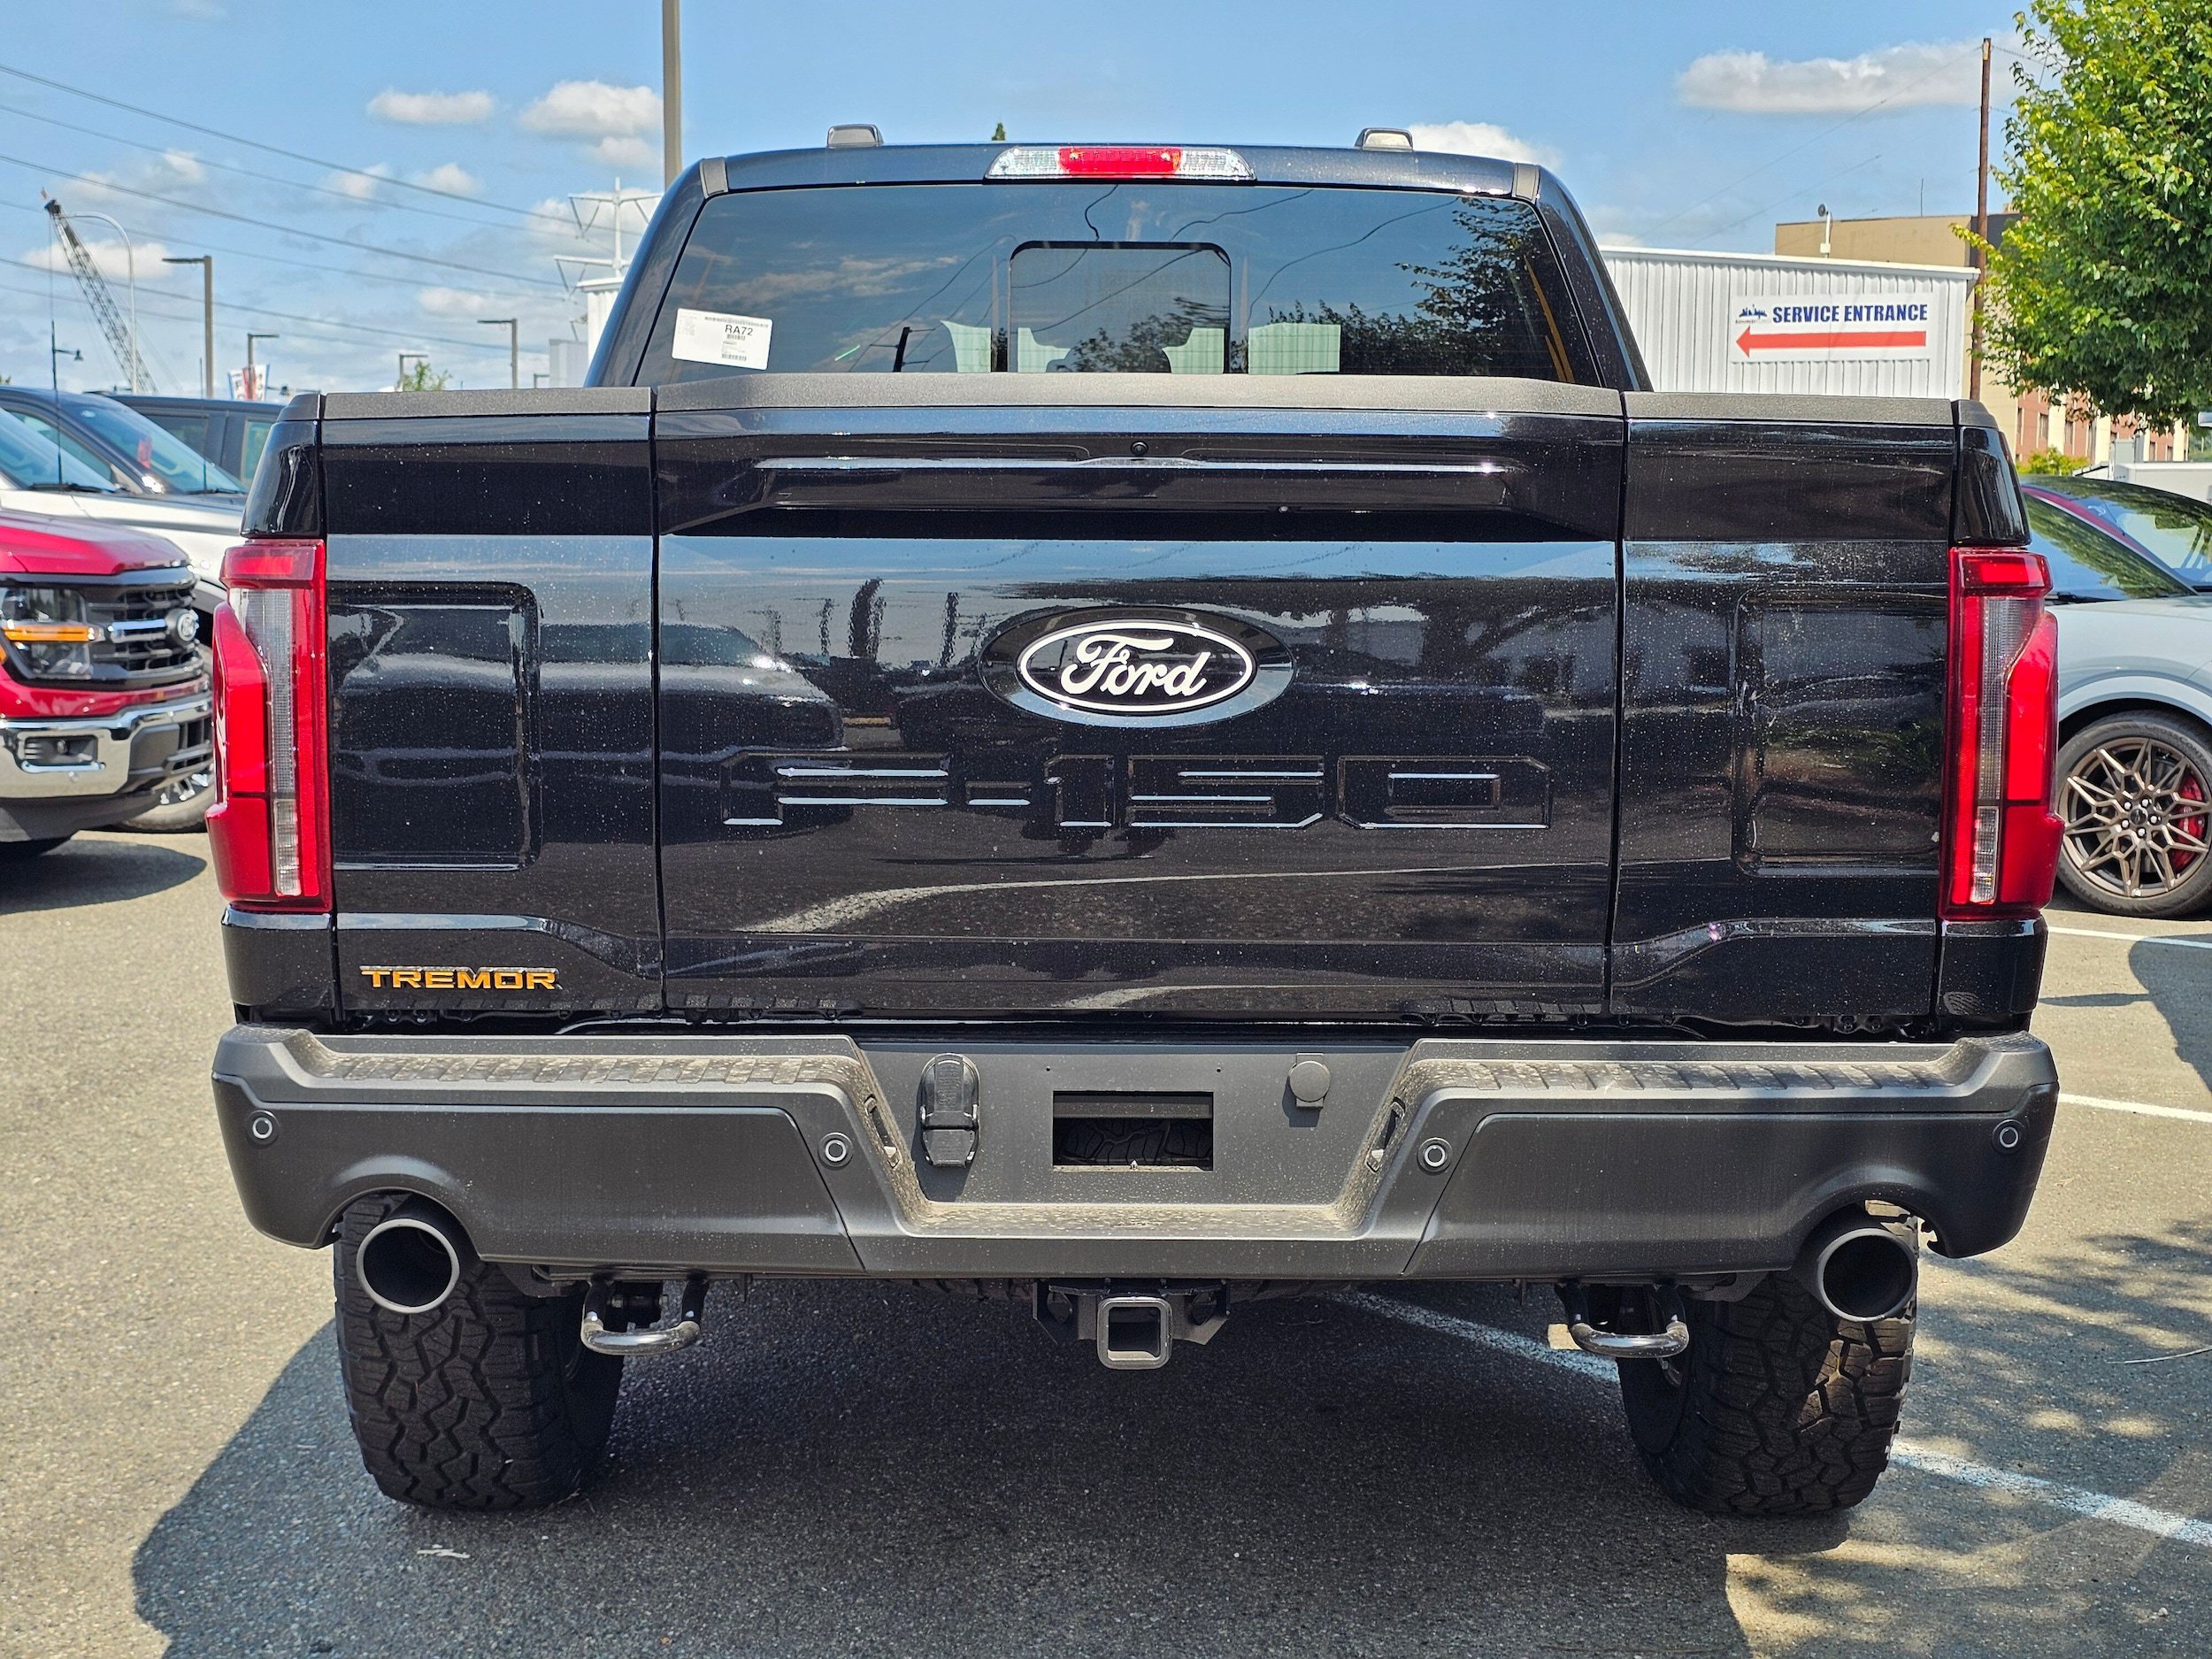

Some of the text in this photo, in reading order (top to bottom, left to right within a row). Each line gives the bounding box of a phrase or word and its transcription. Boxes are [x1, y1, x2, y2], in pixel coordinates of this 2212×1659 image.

[1772, 303, 1928, 324] SERVICE ENTRANCE
[725, 324, 754, 336] RA72
[1060, 634, 1211, 697] Ford
[720, 752, 1552, 830] F-150
[360, 967, 557, 990] TREMOR
